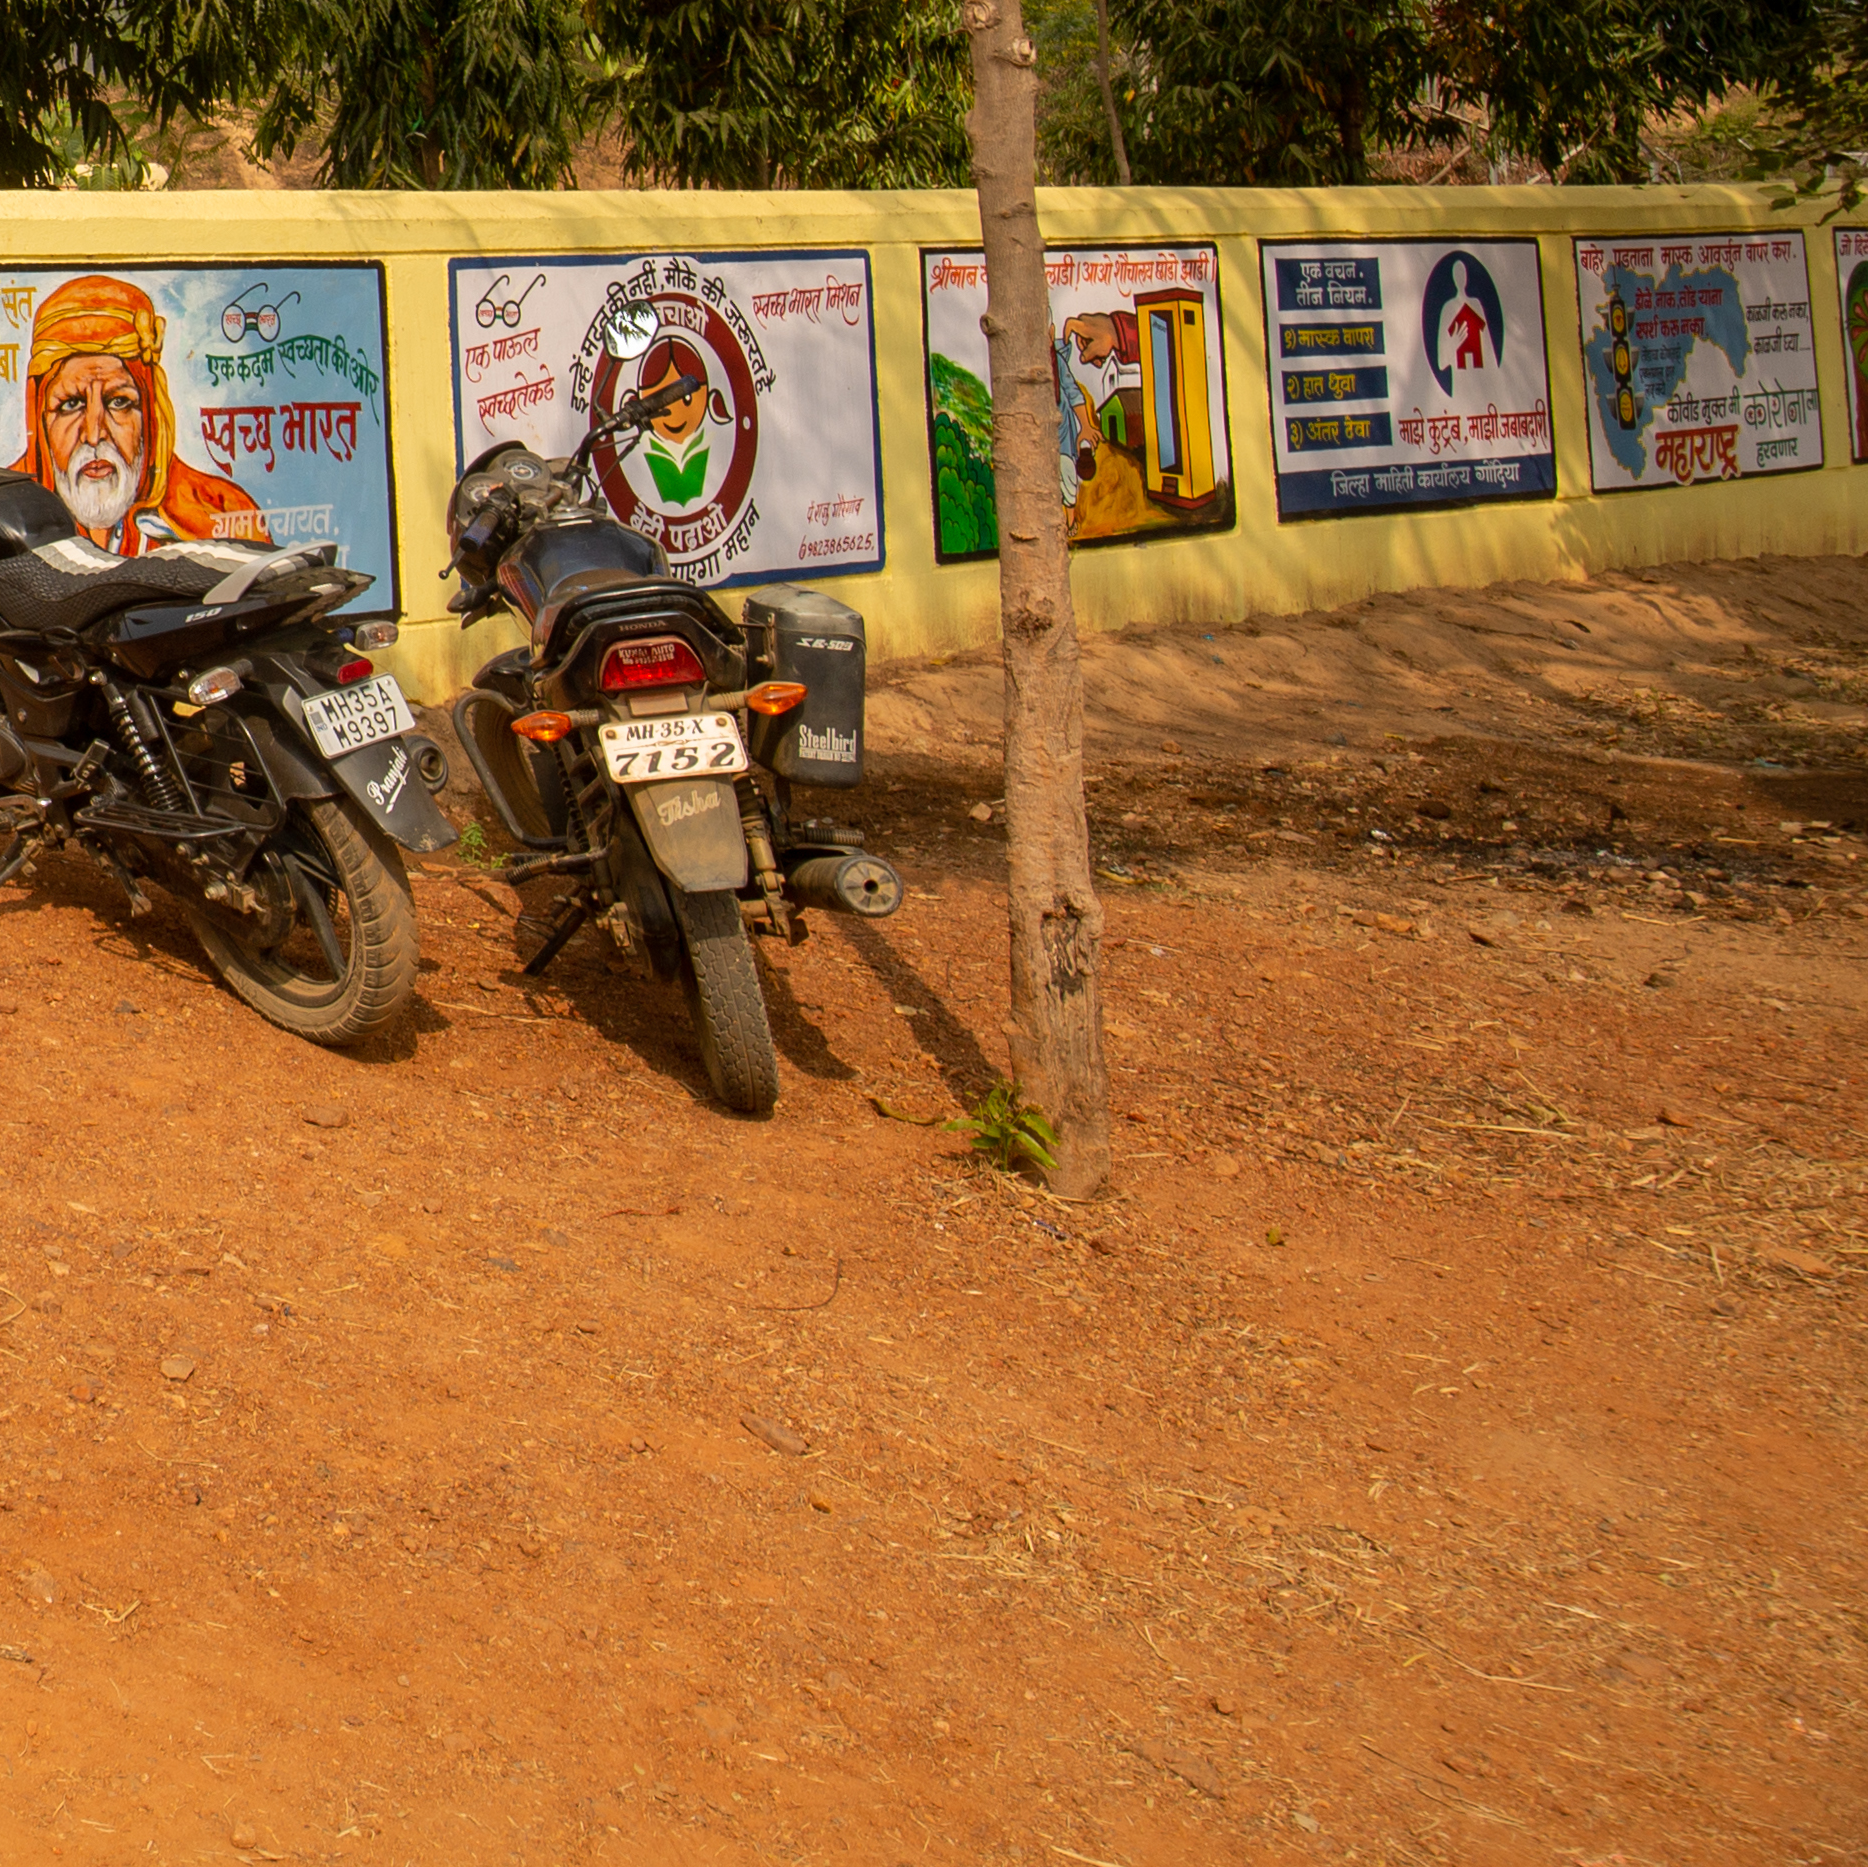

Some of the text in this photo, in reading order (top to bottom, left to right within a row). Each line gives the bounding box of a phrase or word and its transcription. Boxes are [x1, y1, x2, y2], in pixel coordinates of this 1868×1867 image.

[1082, 254, 1113, 285] आओ
[1114, 253, 1154, 298] शौचालय
[1299, 262, 1322, 283] एक
[1579, 243, 1607, 277] बाहेर
[1660, 245, 1693, 269] मास्क
[1745, 242, 1770, 264] वापर
[1, 279, 37, 328] संत
[788, 287, 824, 324] भारत
[826, 274, 863, 326] मिशन
[1295, 280, 1323, 306] तीन
[663, 257, 697, 291] मौके
[701, 276, 726, 308] की
[754, 368, 776, 396] है
[1298, 329, 1340, 347] मास्क
[1342, 327, 1374, 350] वापरा
[465, 327, 541, 383] एक पाऊल
[205, 354, 234, 387] एक
[237, 346, 275, 387] कदम
[331, 334, 350, 378] की
[349, 348, 380, 427] ओर
[1303, 376, 1324, 400] हात
[1398, 406, 1425, 450] माझे
[1467, 403, 1499, 446] माझी
[1701, 397, 1727, 425] मुक्त
[279, 401, 362, 463] भारत
[1306, 417, 1340, 445] अंतर
[1655, 424, 1741, 483] महाराष्ट्र
[1756, 437, 1798, 468] हरवणार
[1330, 470, 1370, 498] जिल्हा
[1373, 465, 1414, 494] माहिती
[1417, 462, 1471, 489] कार्यालय
[722, 497, 760, 561] महान
[184, 606, 222, 623] 150
[618, 620, 667, 631] HONDA
[651, 643, 675, 657] AUTO
[320, 681, 392, 723] MH35A
[333, 705, 397, 748] M9397
[799, 724, 856, 752] Steelbird
[366, 745, 407, 806] Pranjali
[615, 742, 735, 777] 7152
